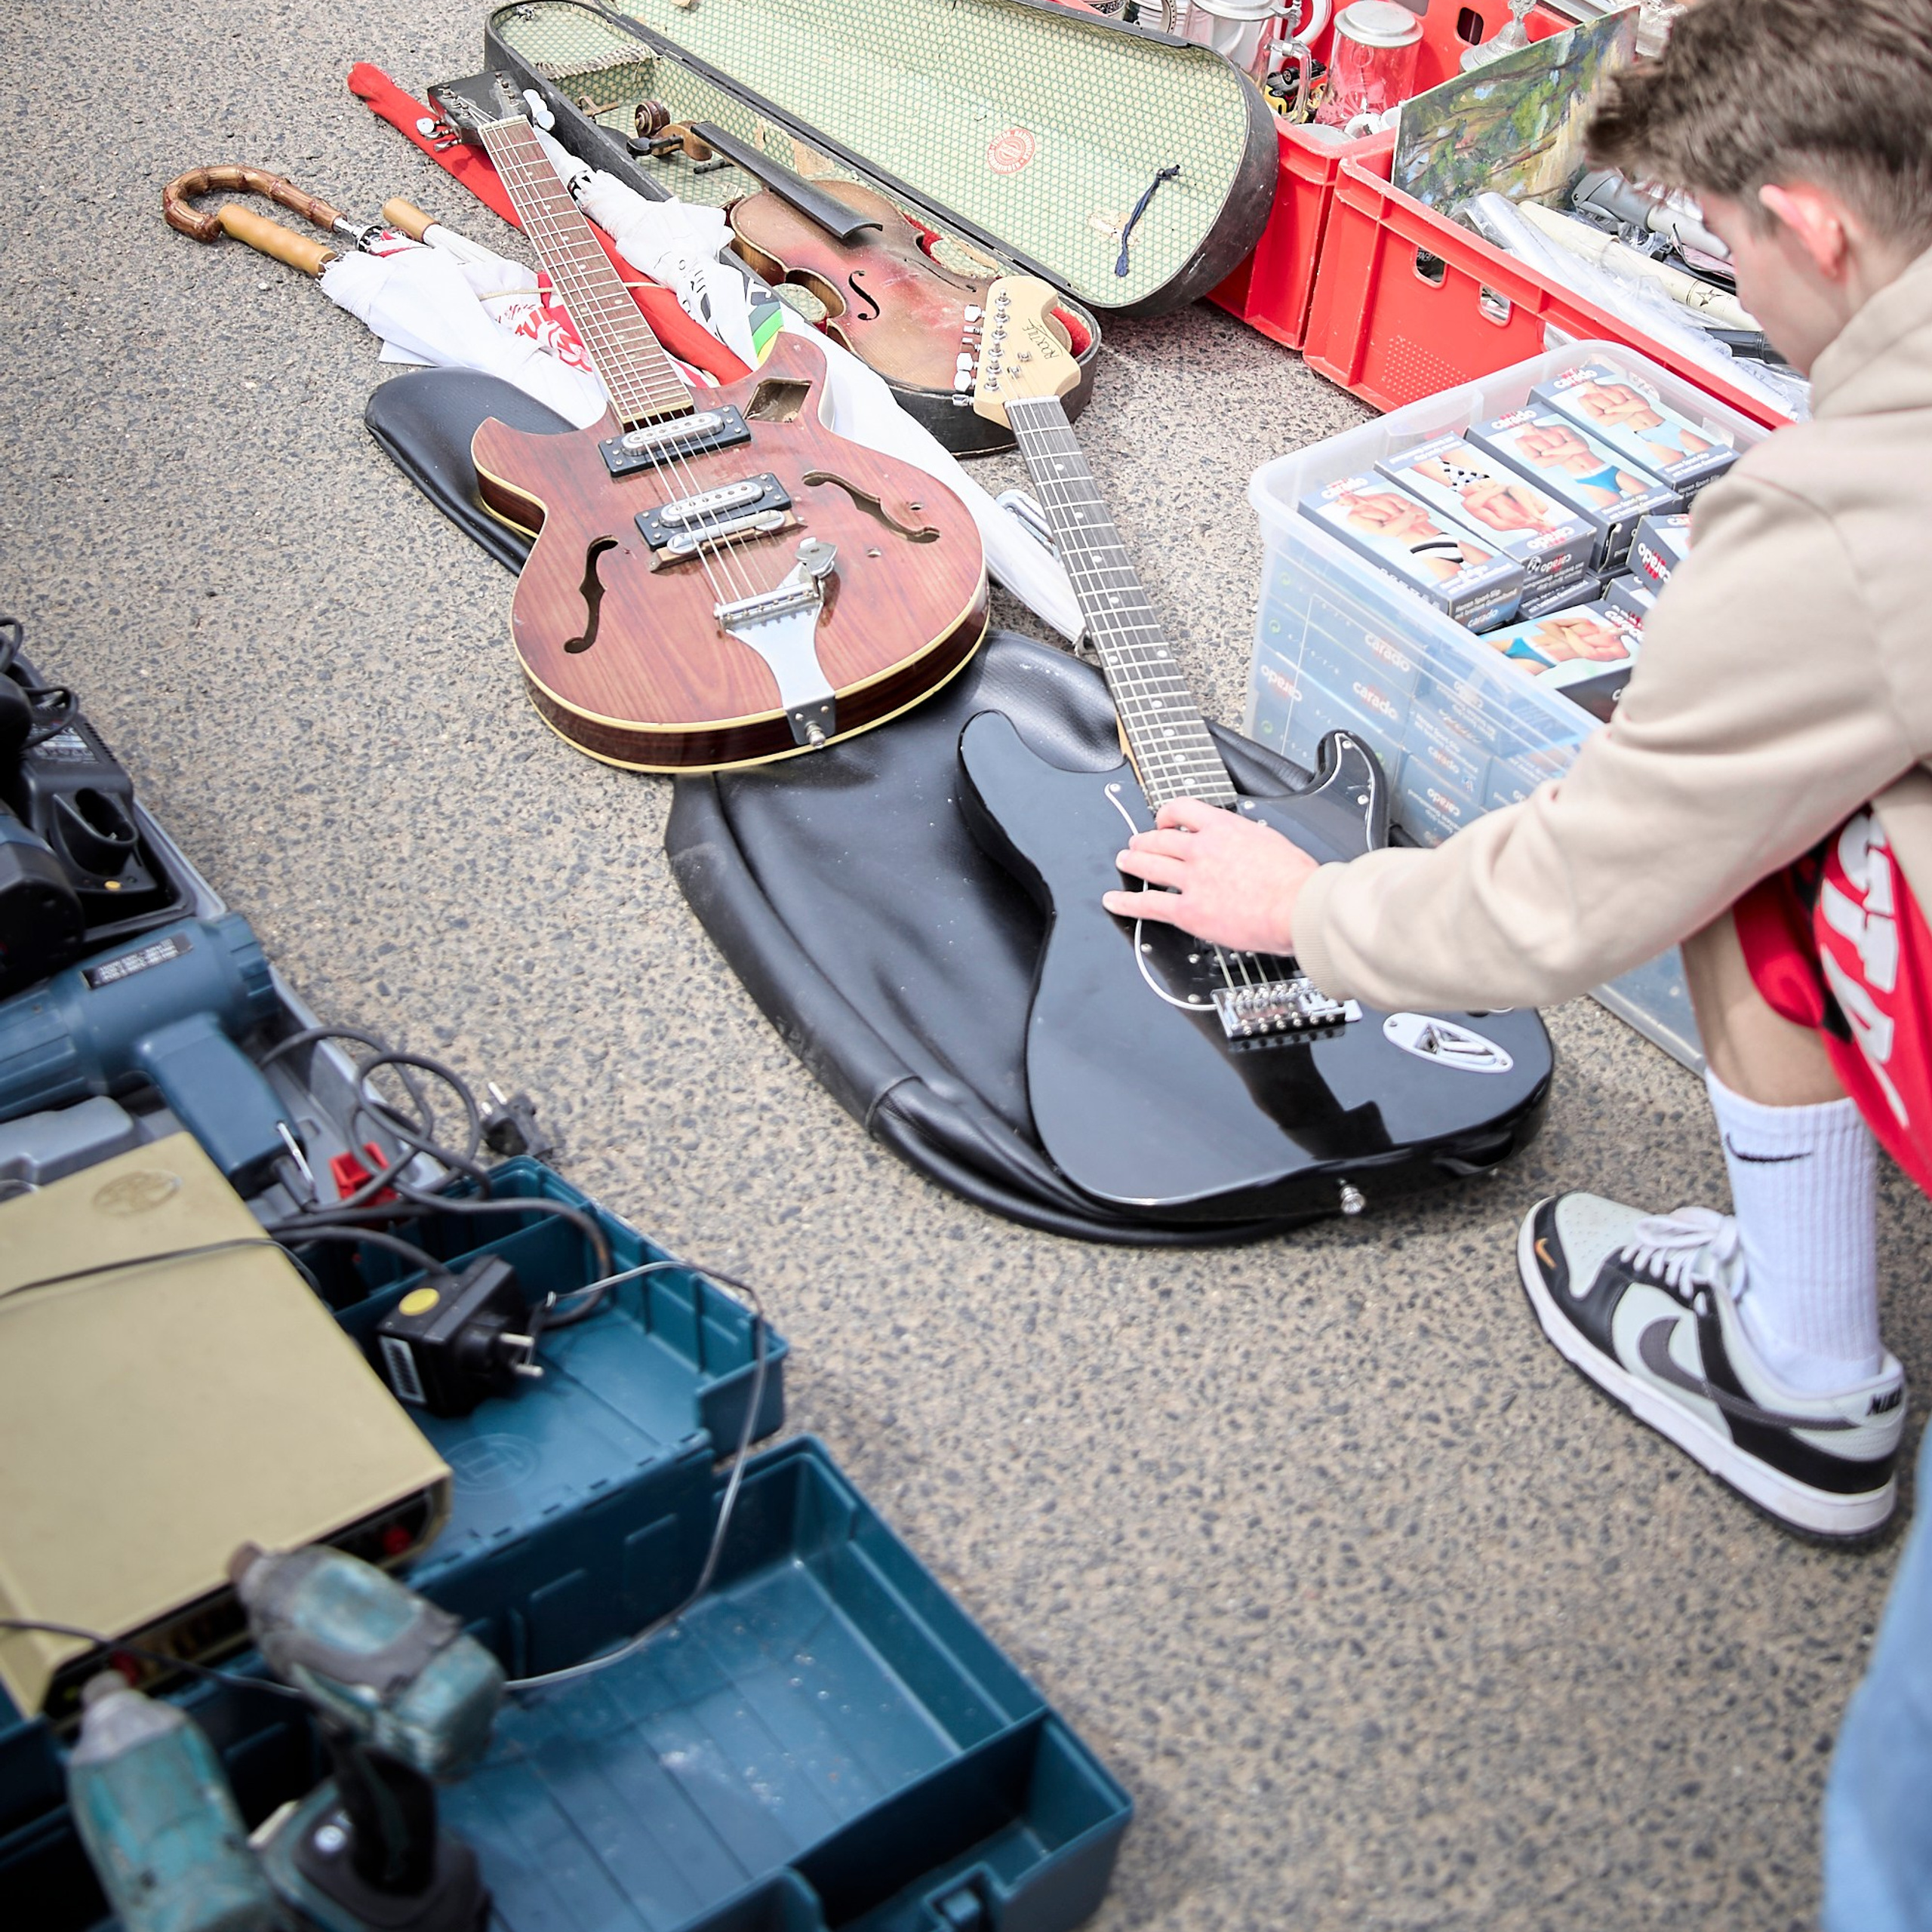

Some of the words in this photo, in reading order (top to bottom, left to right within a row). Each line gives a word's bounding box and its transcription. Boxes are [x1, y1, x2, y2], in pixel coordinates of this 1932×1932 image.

[1553, 368, 1598, 389] carado
[1491, 410, 1537, 429] carado
[1321, 476, 1368, 499] carado
[1527, 526, 1574, 549] carado
[1540, 553, 1572, 573] carado
[1638, 543, 1672, 583] carado
[1467, 609, 1499, 628] carado
[1364, 633, 1411, 672] carado
[1260, 665, 1303, 702] carado
[1352, 681, 1398, 719] carado
[1428, 746, 1460, 774] carado
[1427, 788, 1460, 817] carado
